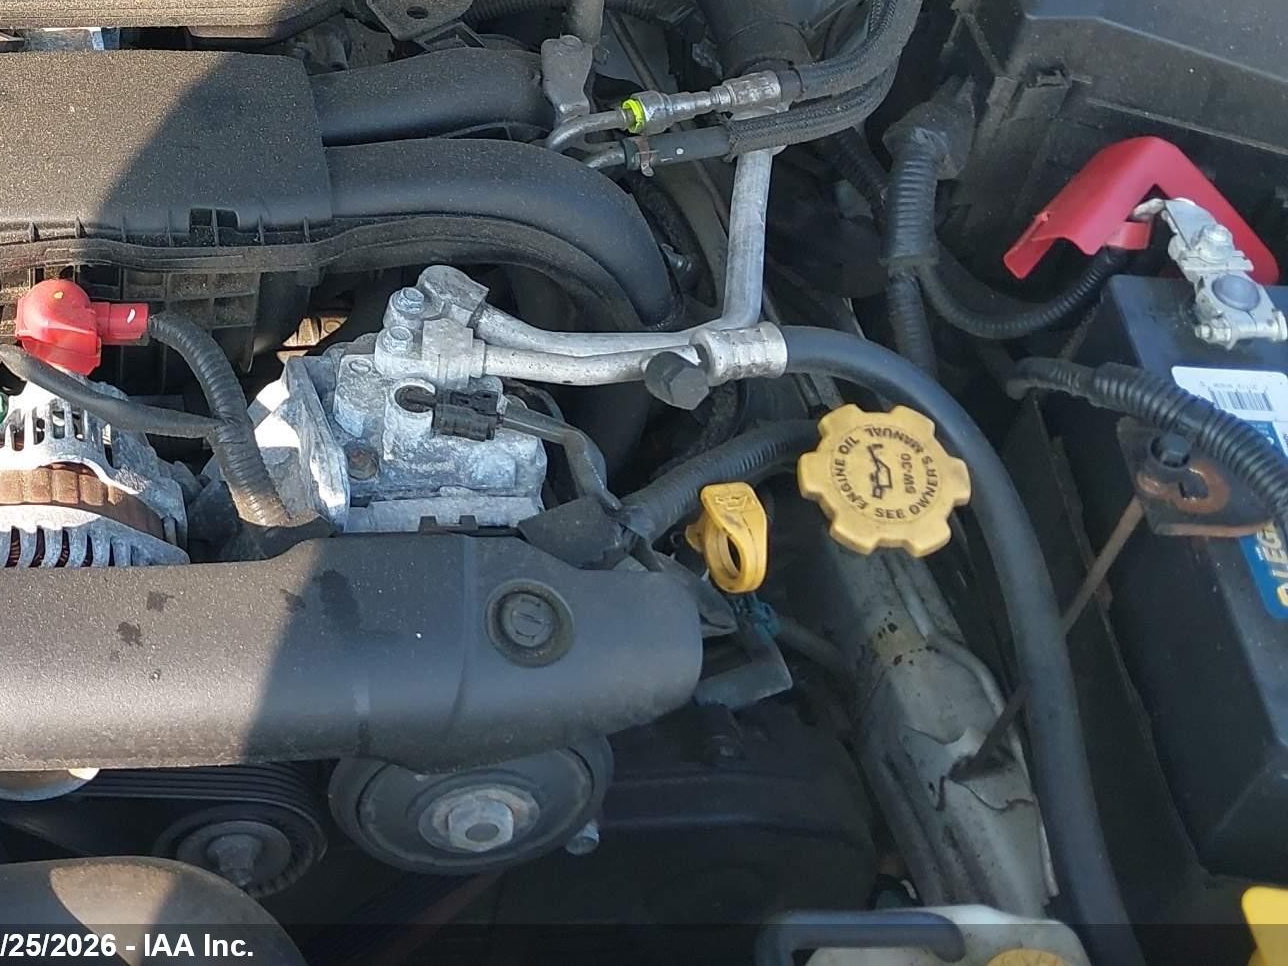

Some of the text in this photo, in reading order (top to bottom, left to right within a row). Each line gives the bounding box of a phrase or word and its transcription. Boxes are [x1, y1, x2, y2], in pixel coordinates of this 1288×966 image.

[864, 427, 924, 454] MANUAL
[834, 436, 869, 510] ENGINE OIL
[875, 507, 905, 520] SEE
